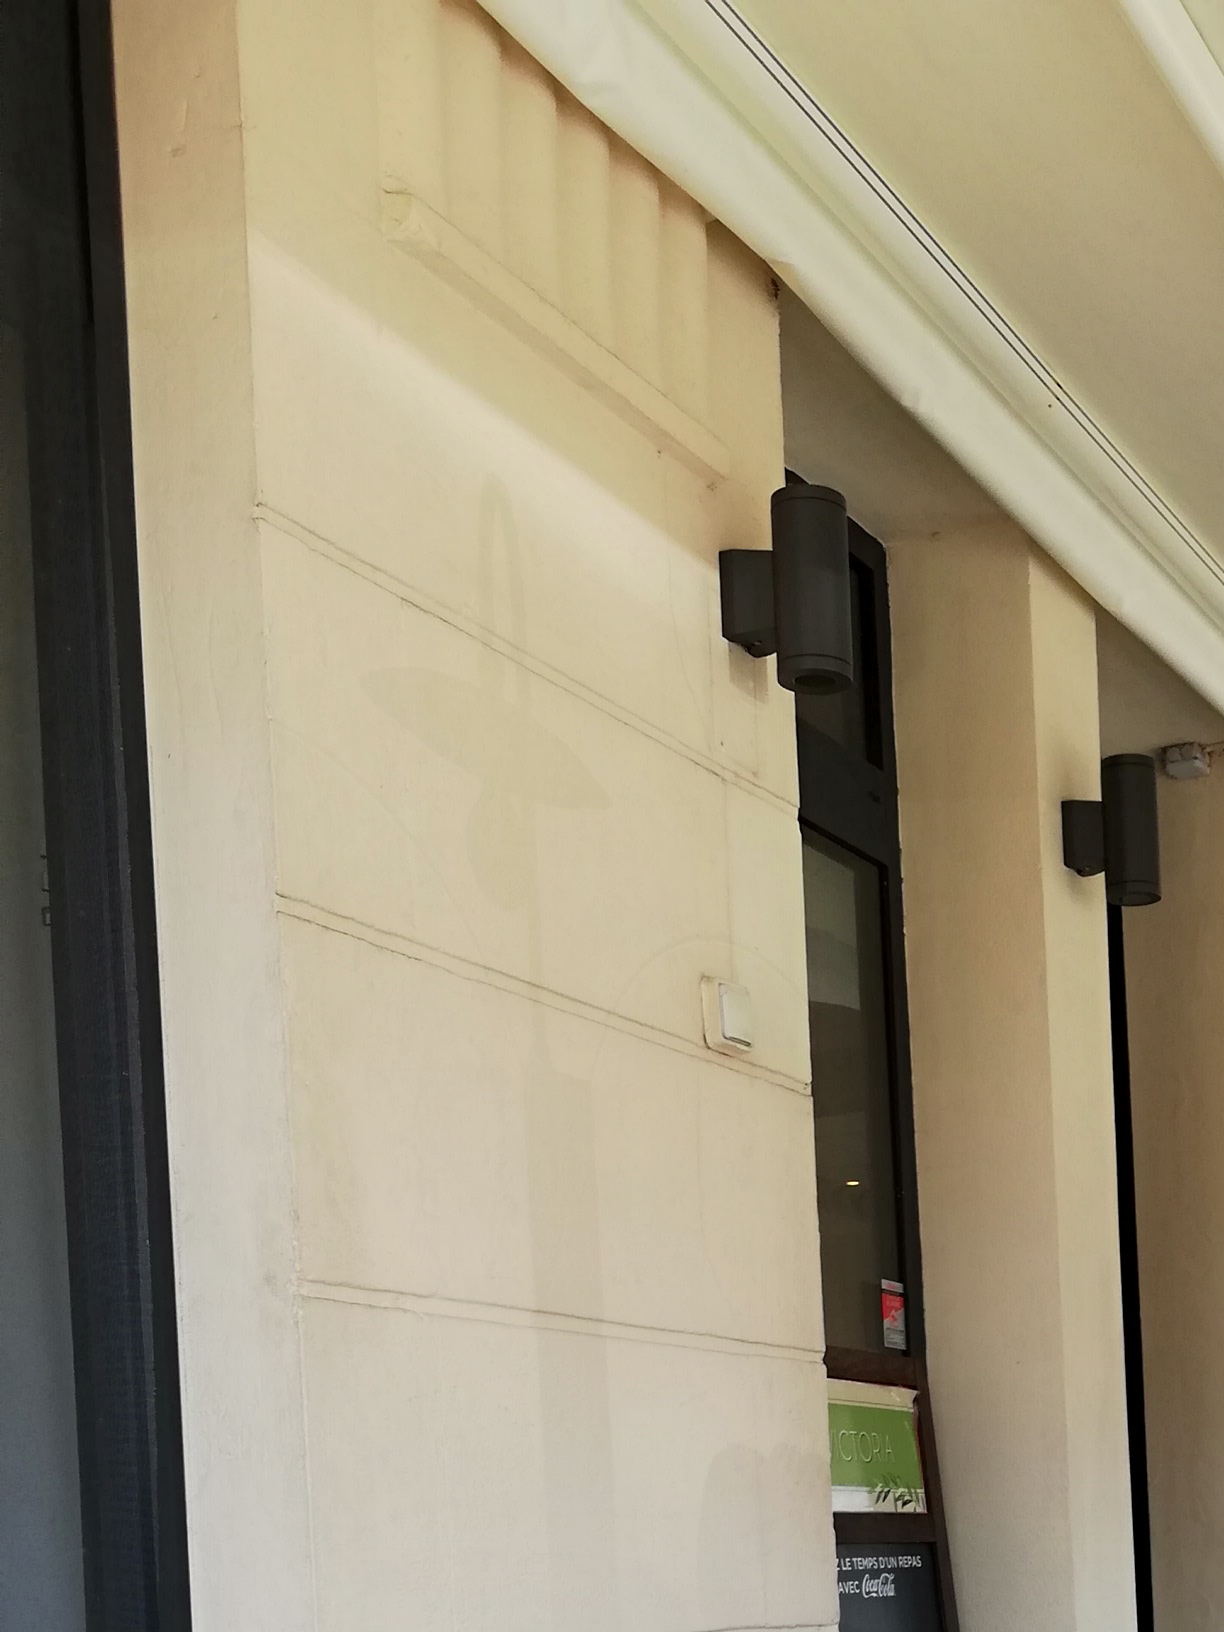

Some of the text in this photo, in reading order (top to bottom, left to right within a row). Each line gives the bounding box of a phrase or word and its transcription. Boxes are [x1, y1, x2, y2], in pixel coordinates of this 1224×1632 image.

[841, 1557, 852, 1571] LE
[852, 1556, 878, 1570] TEMPS
[879, 1556, 897, 1569] D'UN
[898, 1555, 922, 1568] REPAS
[839, 1581, 860, 1594] AVEC
